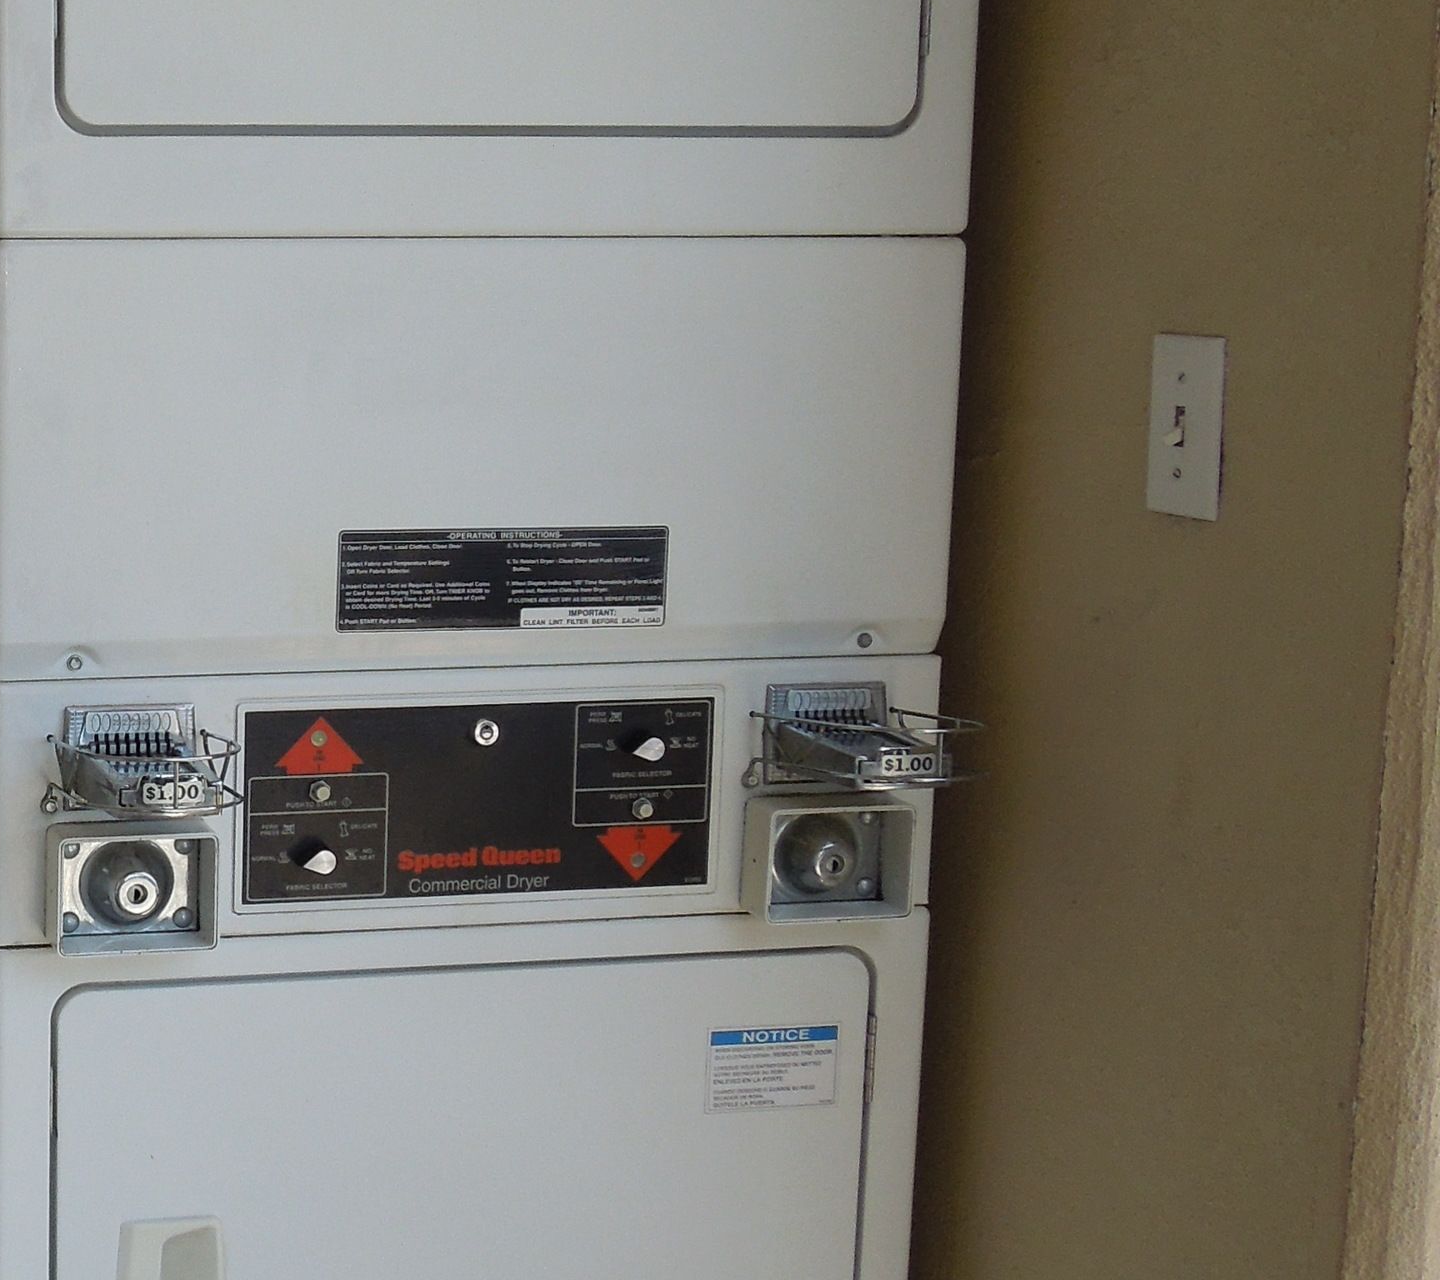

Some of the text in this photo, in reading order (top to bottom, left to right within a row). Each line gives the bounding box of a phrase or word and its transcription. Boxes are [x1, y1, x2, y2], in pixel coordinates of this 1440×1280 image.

[884, 756, 933, 772] $1.00
[145, 784, 199, 801] $1.00
[397, 845, 561, 875] Speed Queen
[409, 873, 550, 894] Commercial Dryer
[742, 1028, 810, 1043] NOTICE
